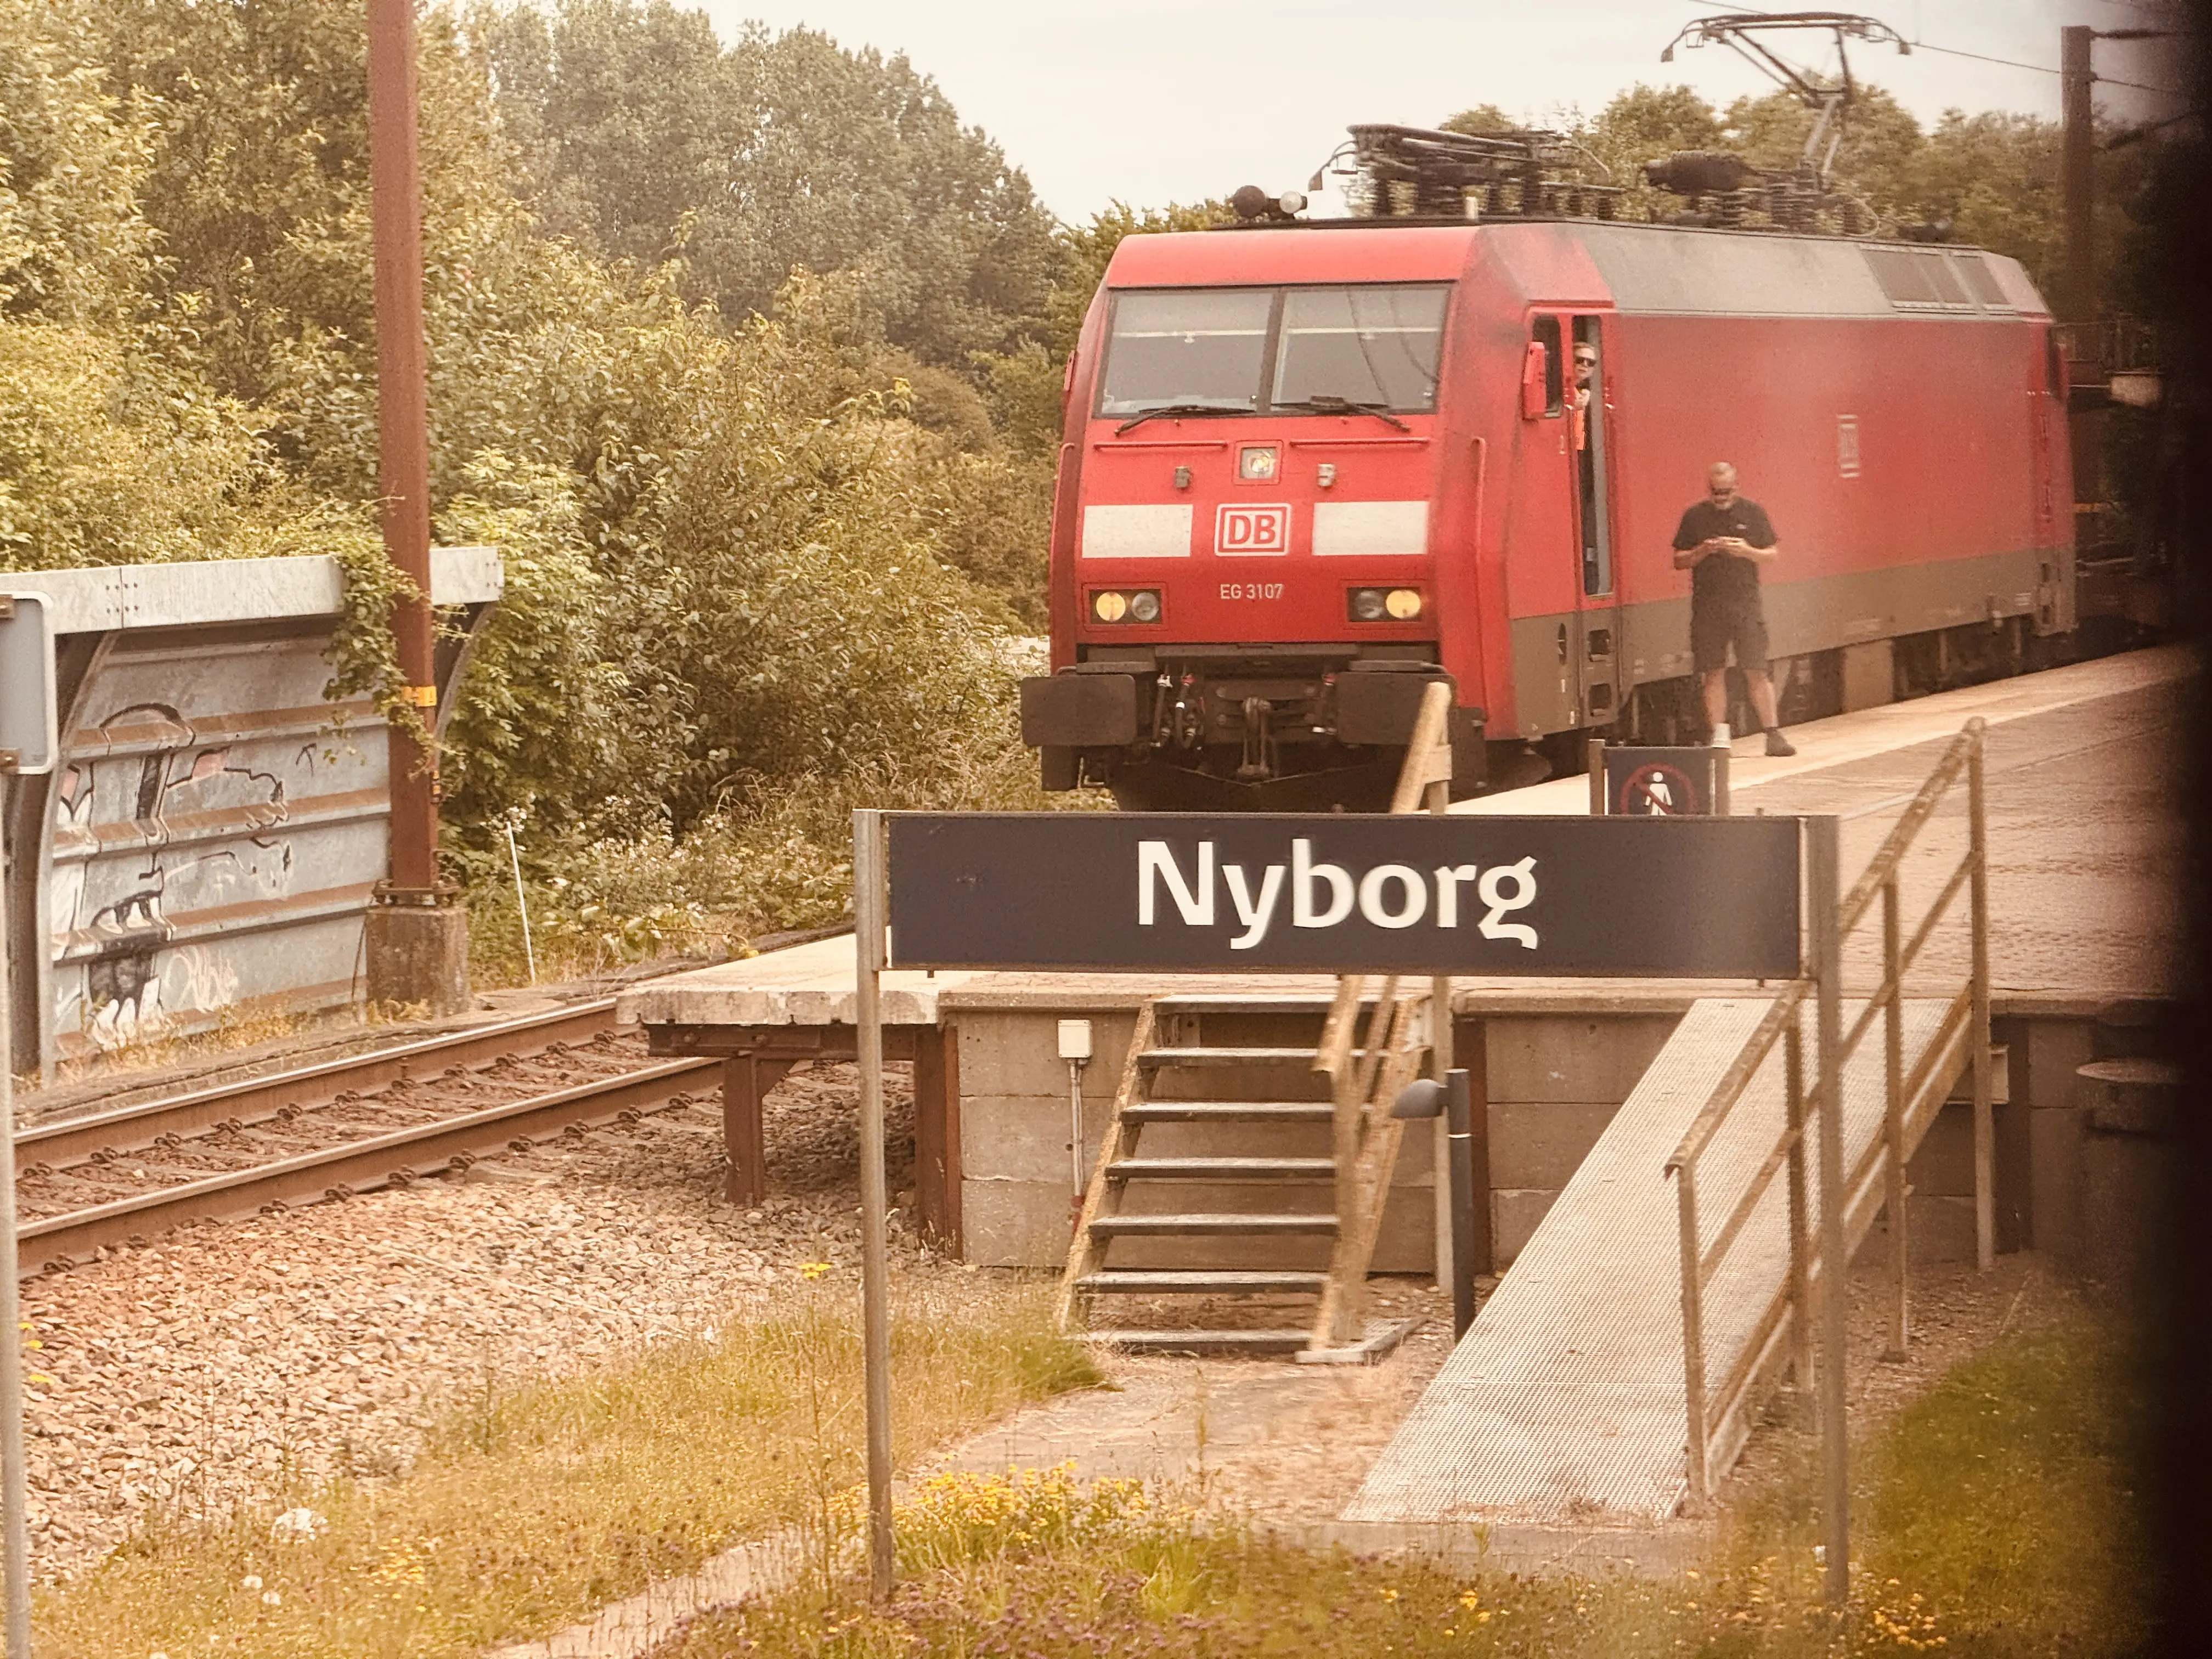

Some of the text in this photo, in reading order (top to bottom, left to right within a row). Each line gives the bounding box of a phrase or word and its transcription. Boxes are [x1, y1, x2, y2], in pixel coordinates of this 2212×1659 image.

[1228, 515, 1276, 544] DB
[1220, 583, 1283, 600] EG 3107
[1137, 838, 1538, 950] Nyborg
